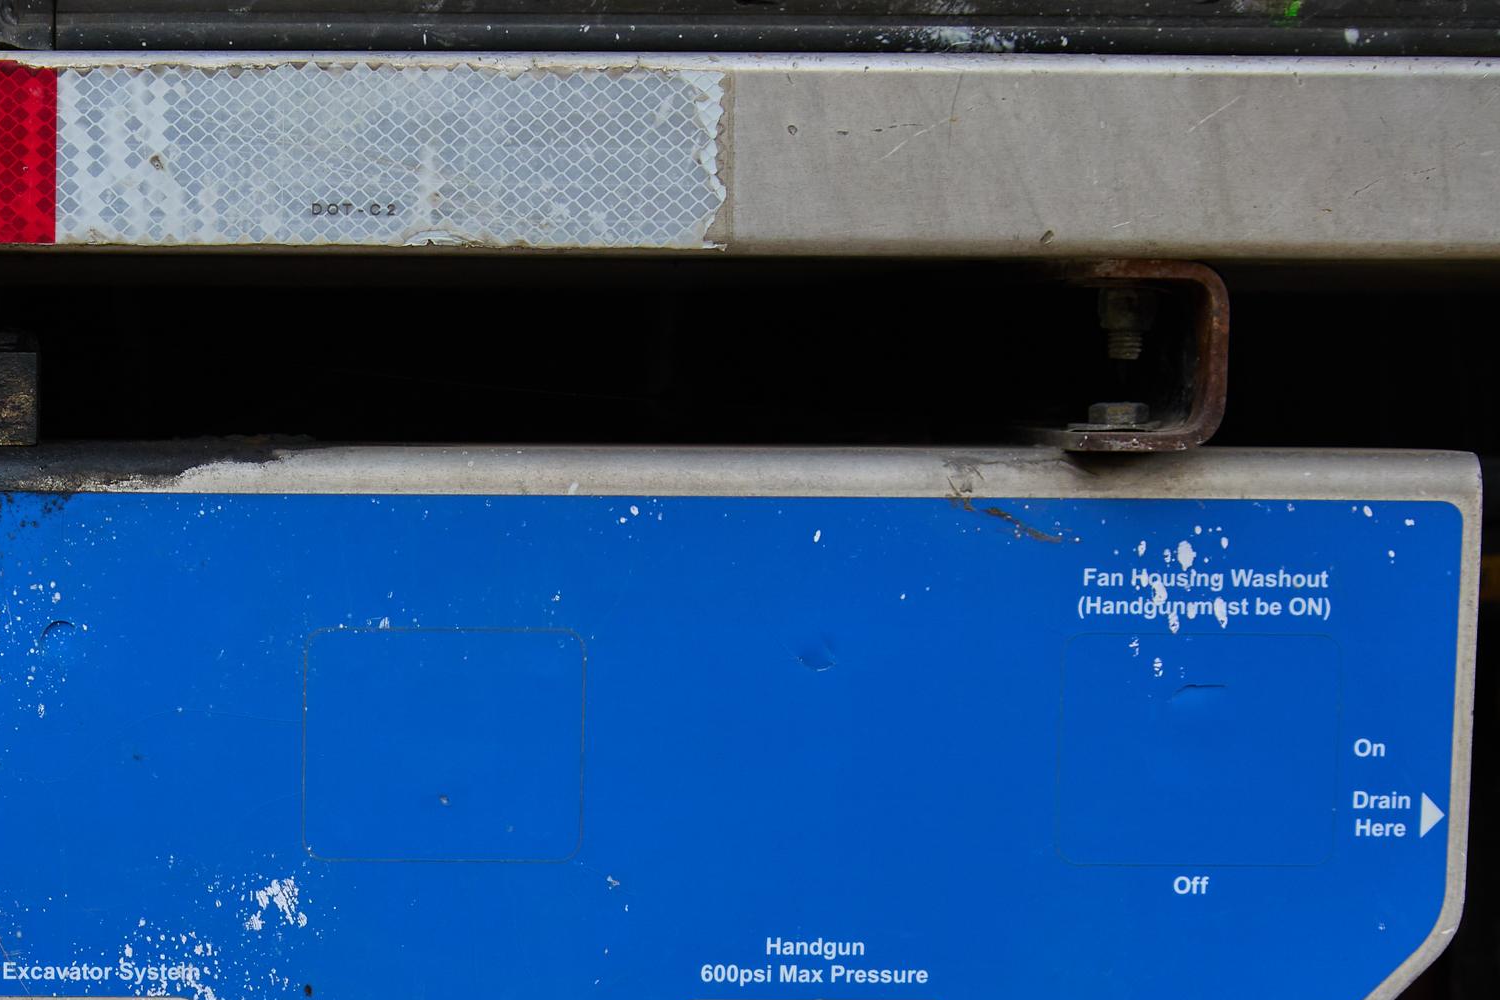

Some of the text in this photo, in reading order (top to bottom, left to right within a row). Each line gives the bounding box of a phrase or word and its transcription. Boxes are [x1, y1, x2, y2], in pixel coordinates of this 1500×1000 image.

[311, 203, 396, 216] DOT-C2
[1084, 568, 1328, 592] Fan Housing Washout
[1078, 597, 1186, 619] (Handgun
[1256, 598, 1281, 615] be
[1290, 598, 1330, 619] ON)
[1355, 739, 1385, 756] On
[1354, 791, 1410, 808] Drain
[1356, 819, 1405, 836] Here
[1174, 877, 1209, 894] Off
[767, 938, 864, 959] Handgun
[3, 962, 111, 980] Excavator
[119, 962, 201, 985] System
[701, 965, 928, 986] 600psi Max Pressure
